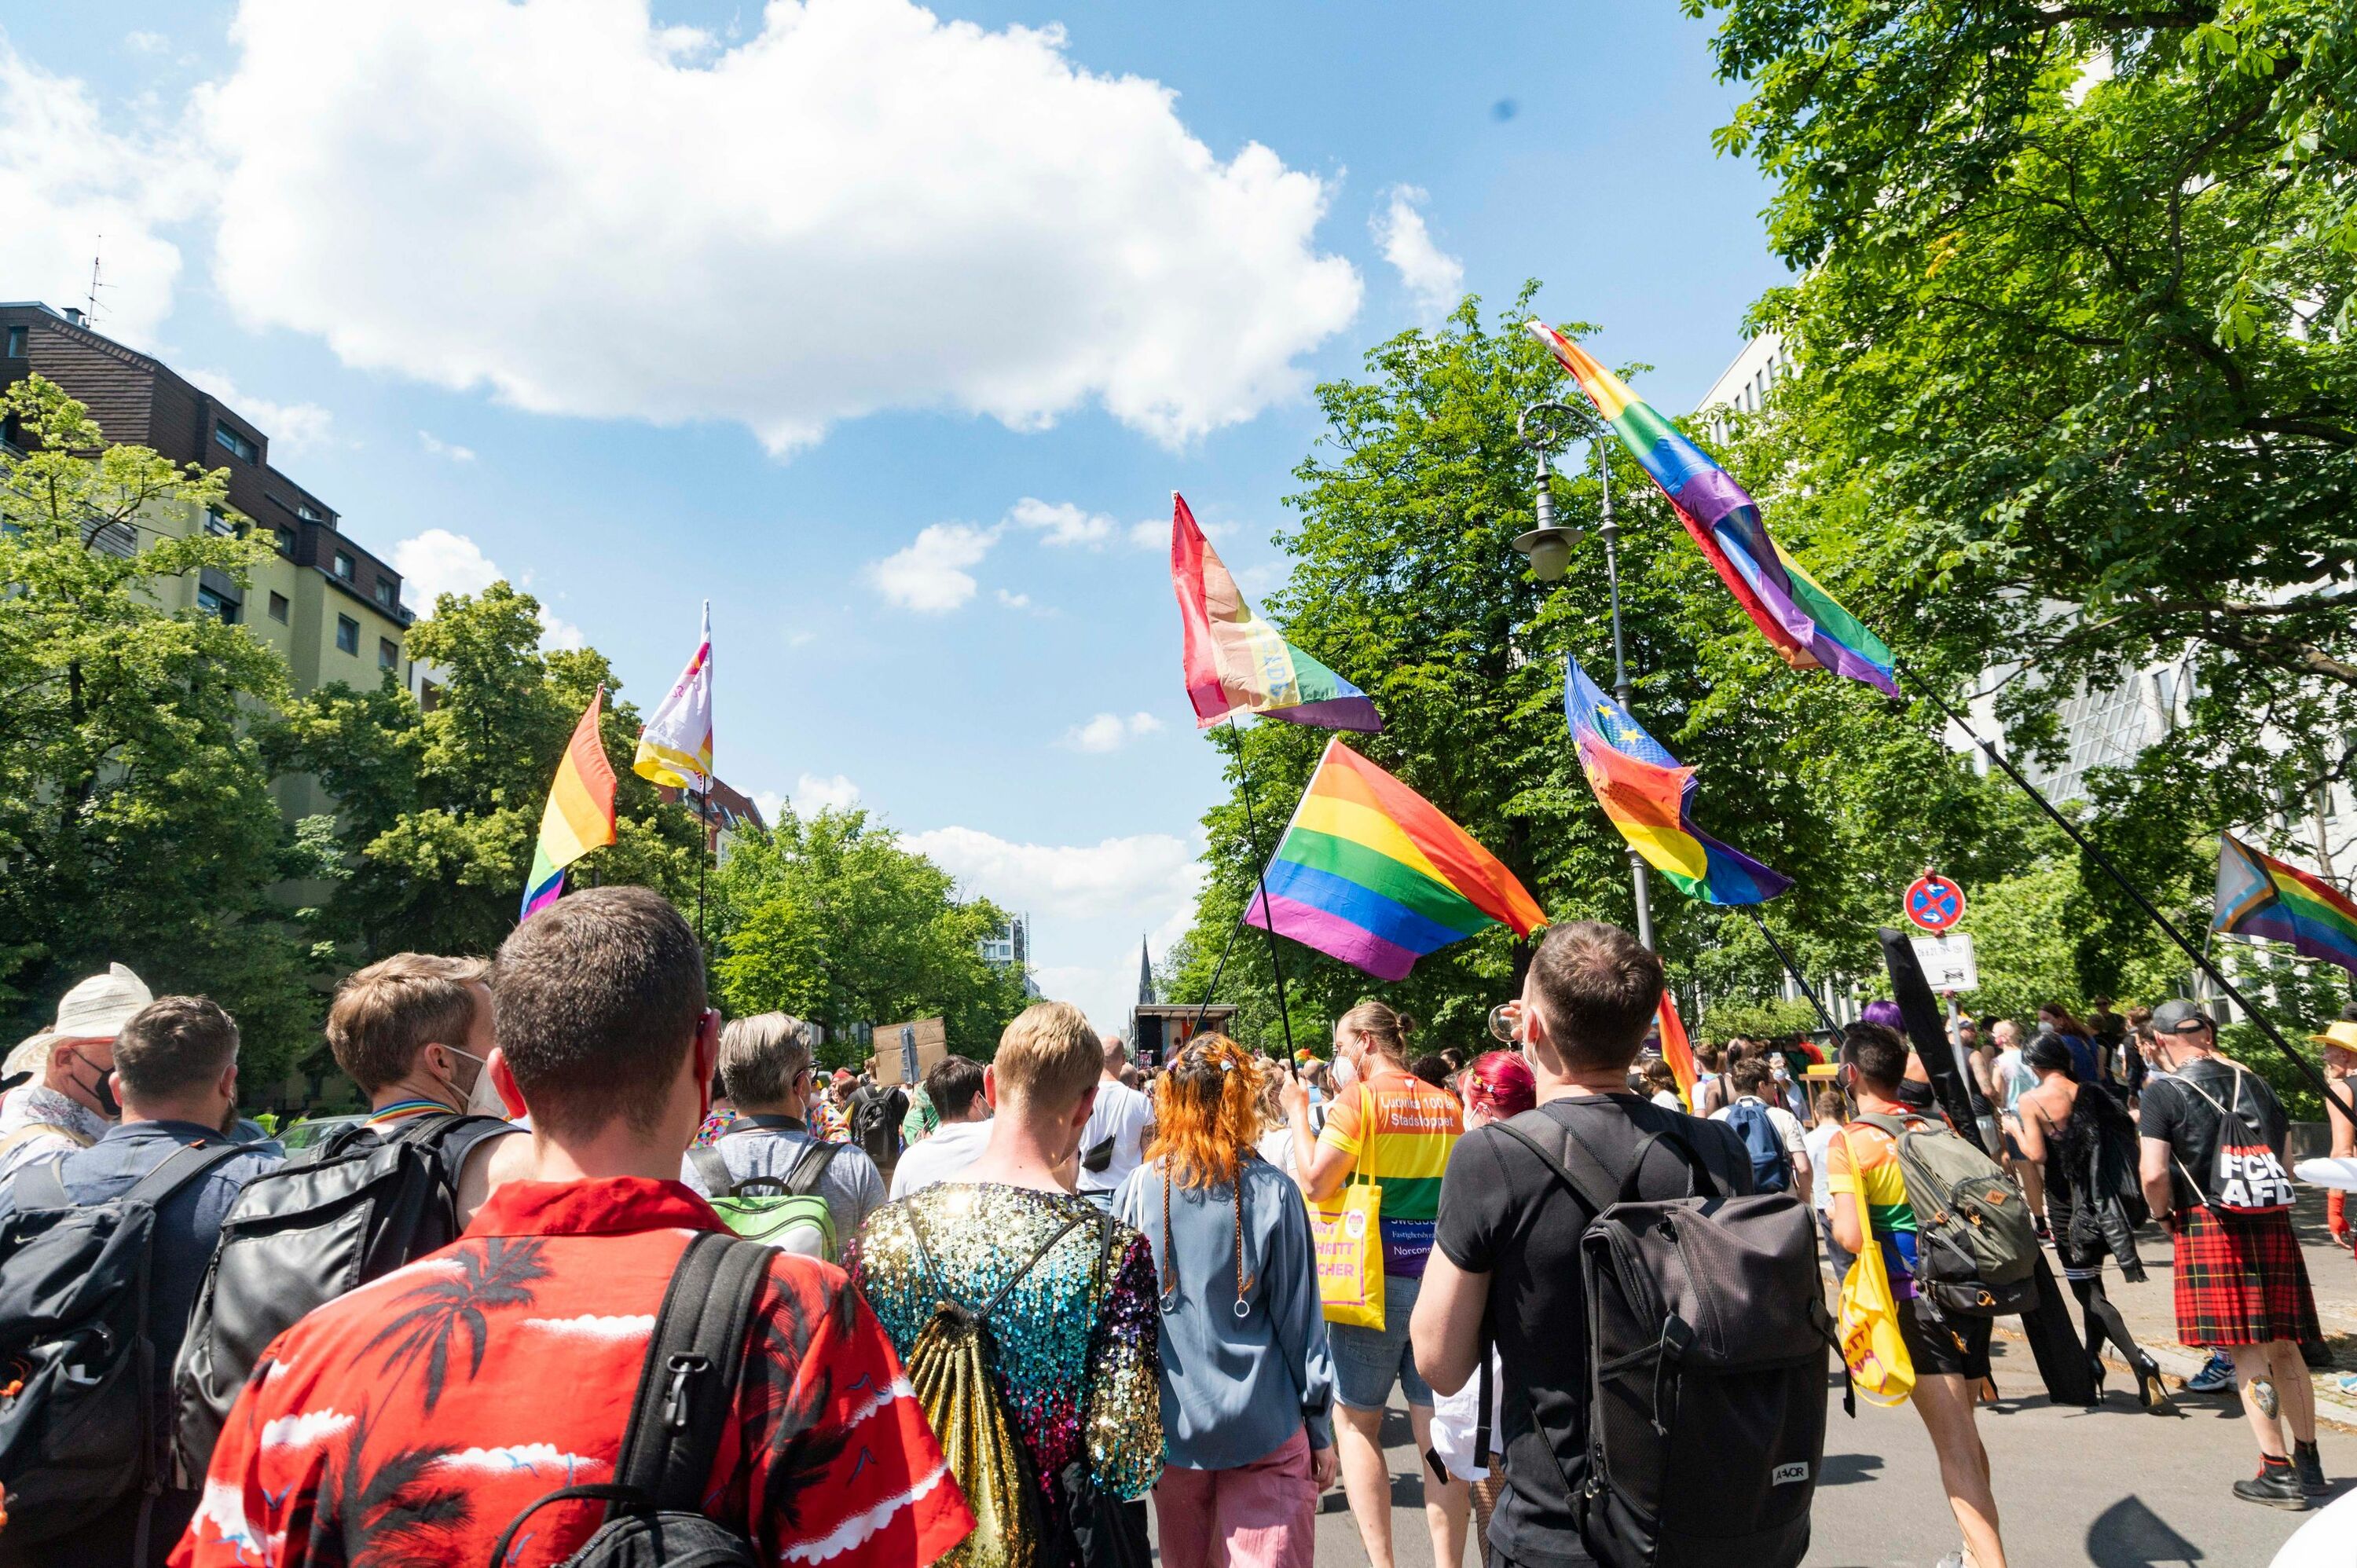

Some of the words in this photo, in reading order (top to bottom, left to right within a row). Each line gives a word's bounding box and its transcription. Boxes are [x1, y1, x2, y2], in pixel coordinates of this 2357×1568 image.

[1424, 1097, 1443, 1108] 100
[1391, 1113, 1453, 1129] Stadsloppet
[2220, 1152, 2288, 1181] FCK
[2221, 1178, 2297, 1207] AFD
